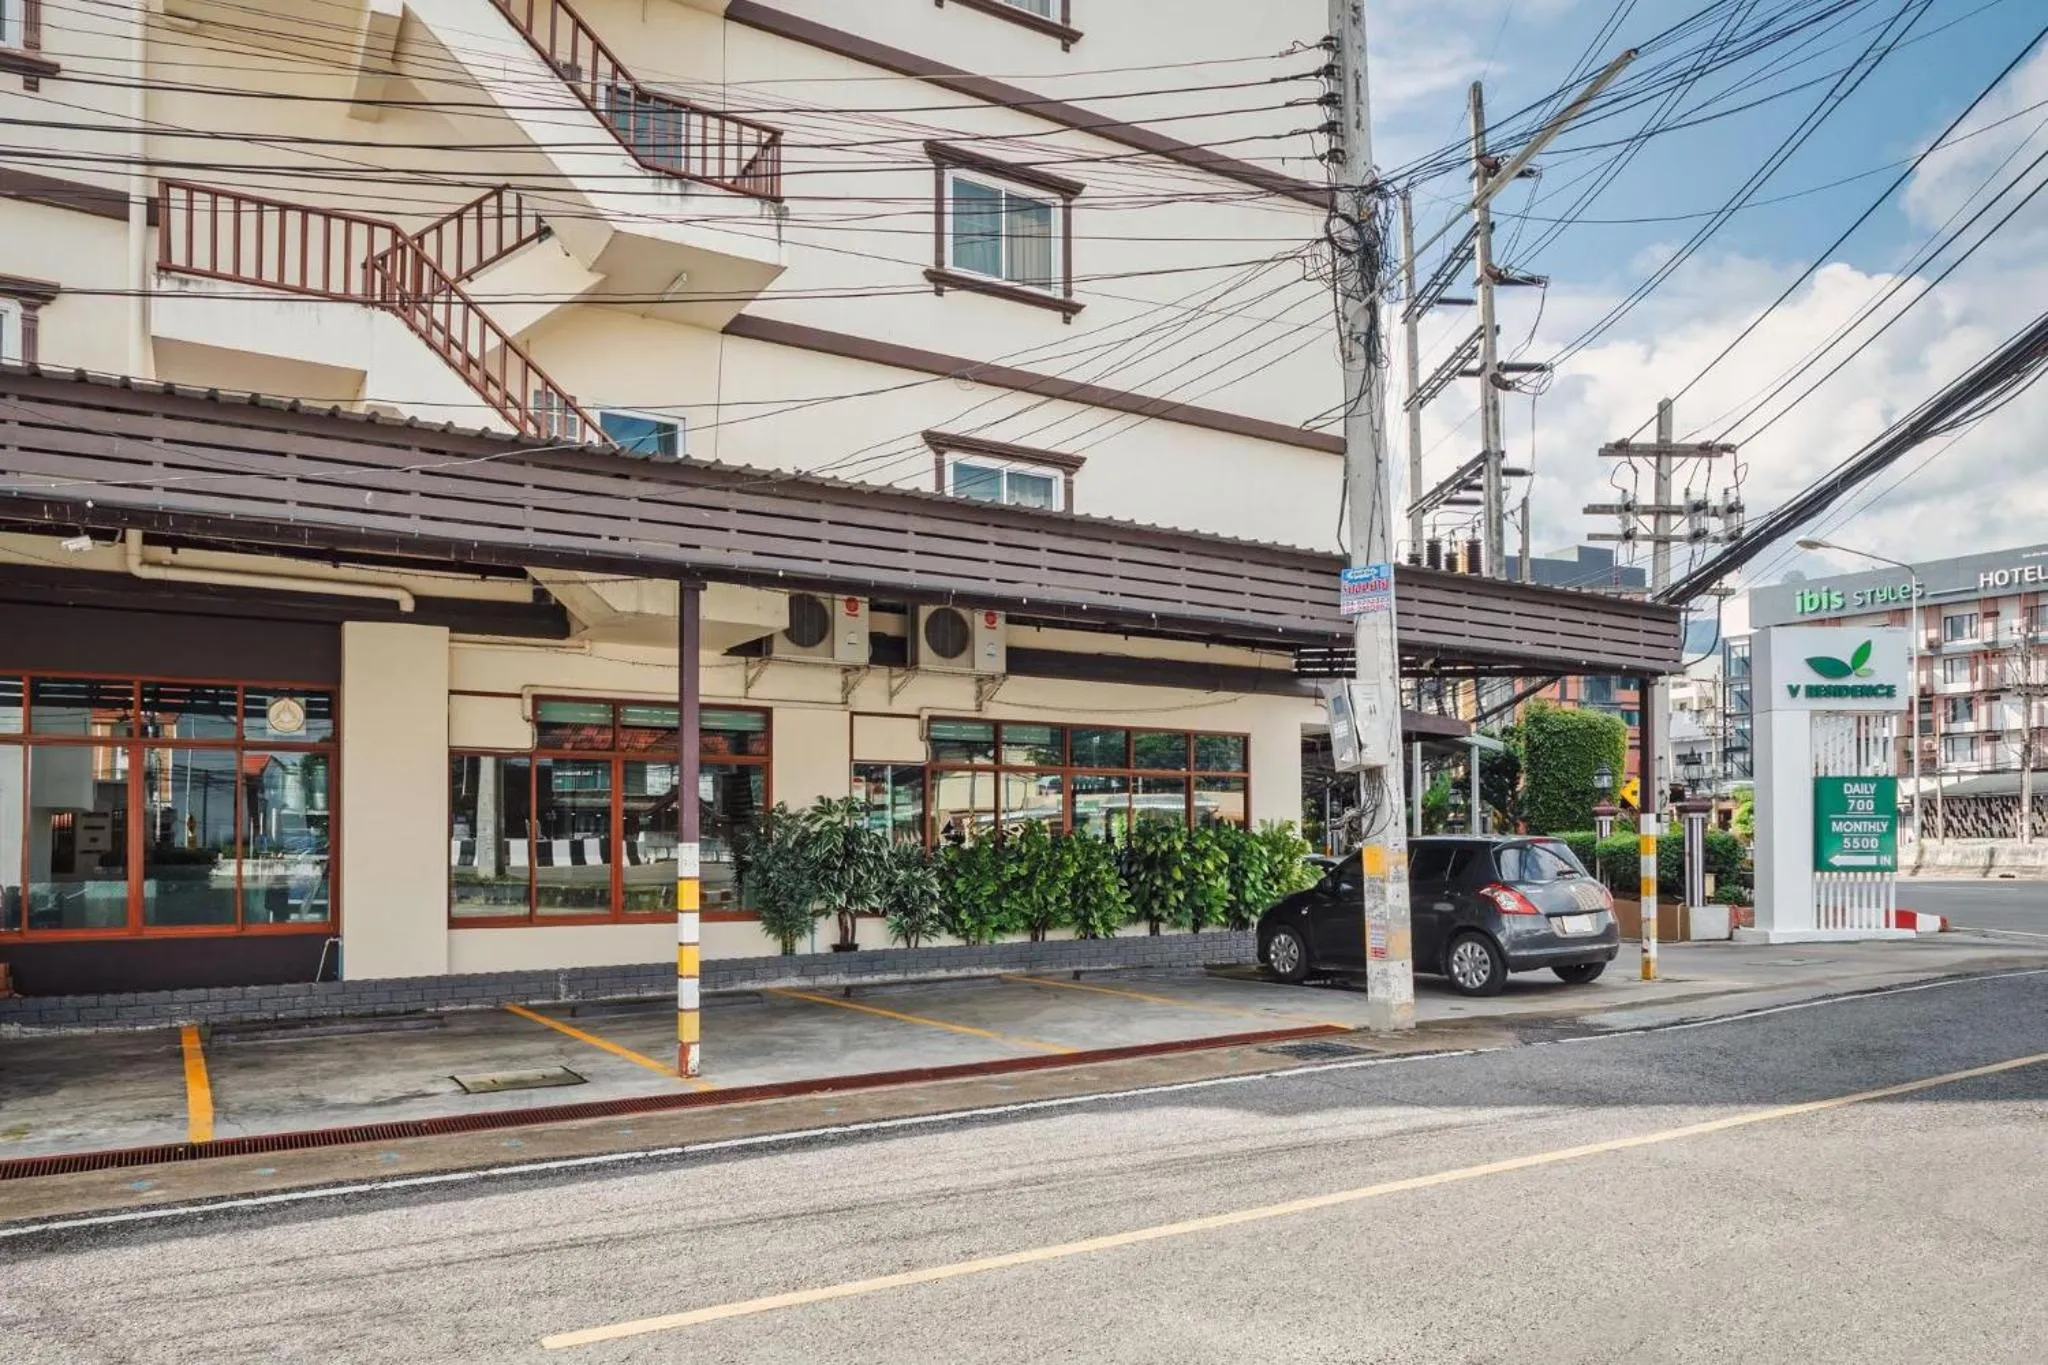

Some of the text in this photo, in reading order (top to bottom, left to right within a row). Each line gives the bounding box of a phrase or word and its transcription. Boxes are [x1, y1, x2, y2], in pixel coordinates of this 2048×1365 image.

[1795, 586, 1843, 613] ibis
[1979, 564, 2048, 588] HOTEL
[1787, 684, 1897, 698] V RESIDENCE
[1843, 783, 1877, 795] DAILY
[1848, 799, 1874, 811] 700
[1831, 821, 1889, 832] MONTHLY
[1843, 837, 1879, 849] 5500
[1880, 855, 1892, 866] IN
